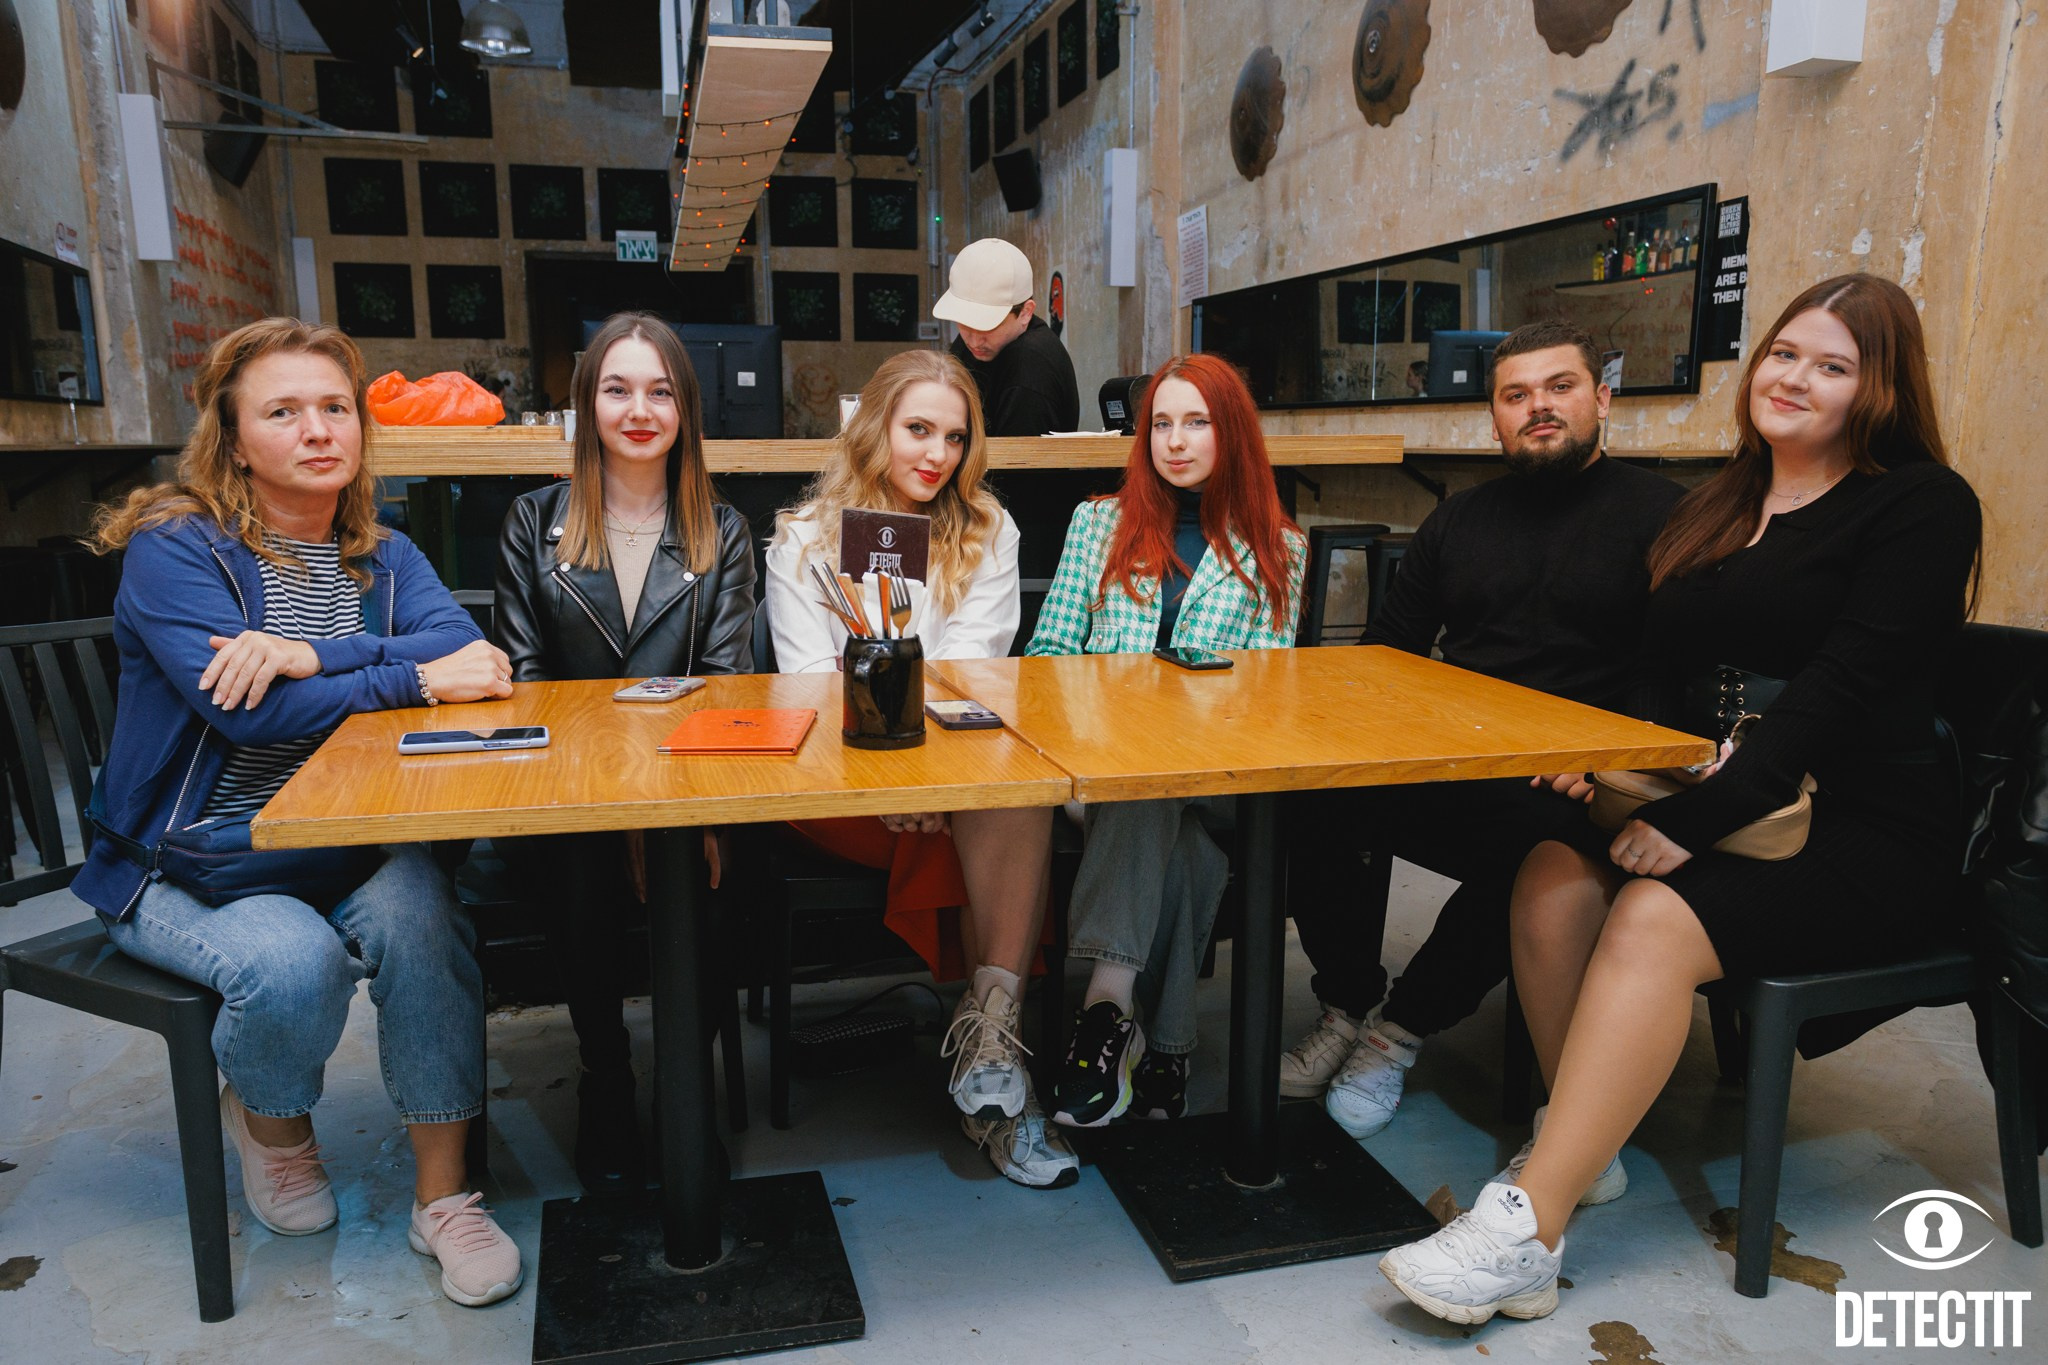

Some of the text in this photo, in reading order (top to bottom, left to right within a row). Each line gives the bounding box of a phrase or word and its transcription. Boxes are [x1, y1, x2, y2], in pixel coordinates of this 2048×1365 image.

[618, 239, 656, 260] יציאה
[1721, 254, 1747, 270] MEM
[1715, 272, 1737, 288] ARE
[1712, 289, 1741, 305] THEN
[1497, 1197, 1514, 1215] adidas
